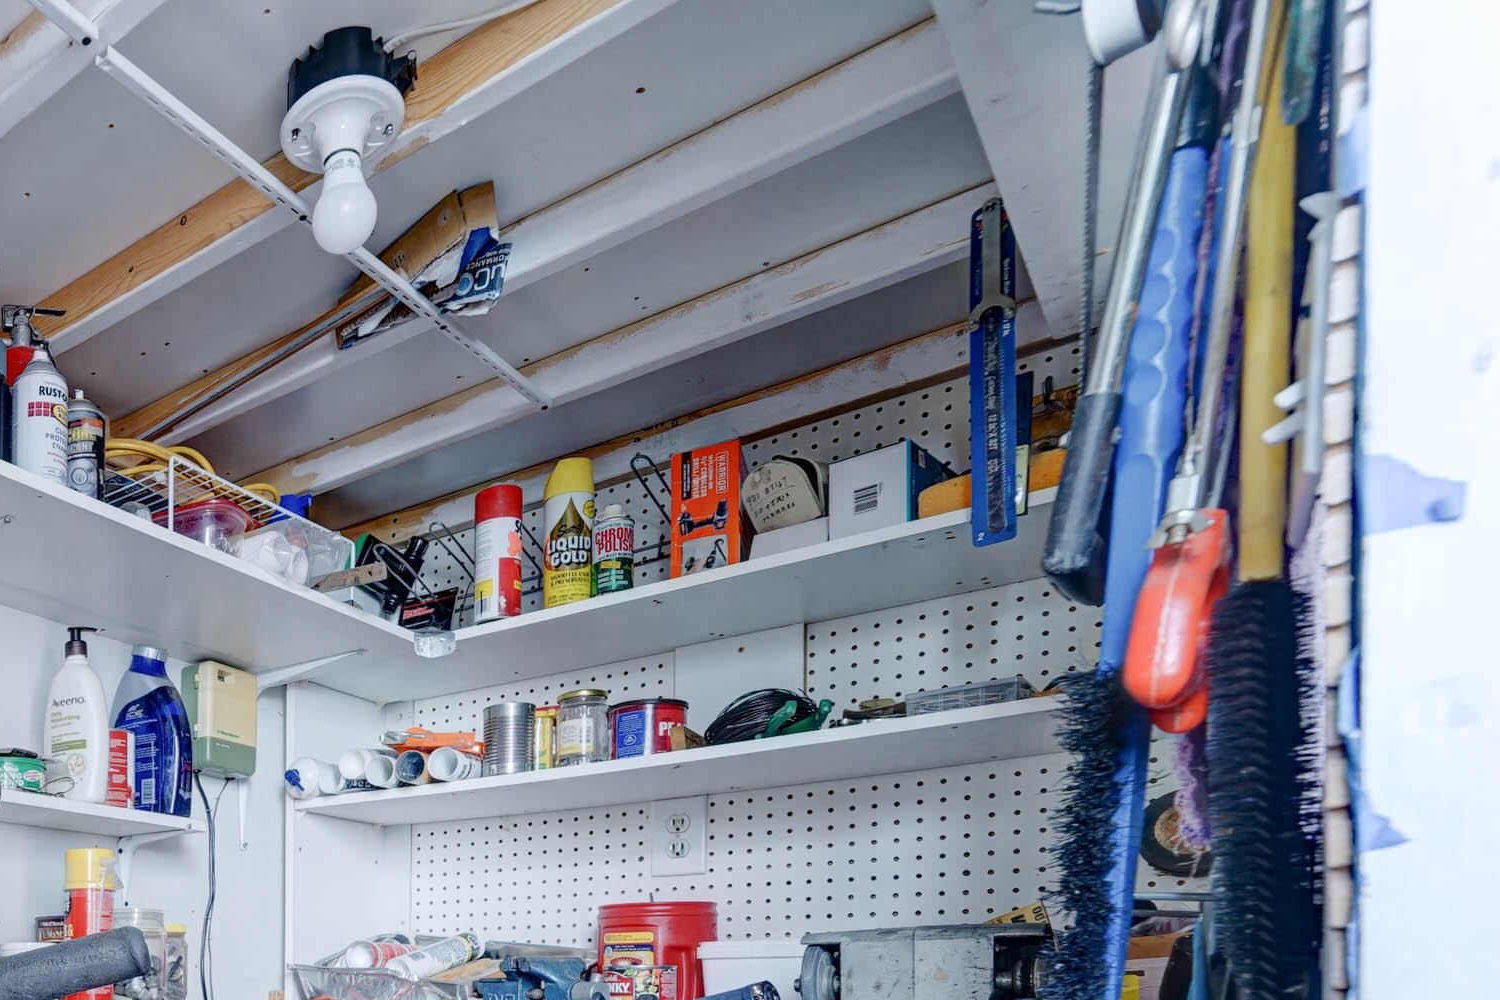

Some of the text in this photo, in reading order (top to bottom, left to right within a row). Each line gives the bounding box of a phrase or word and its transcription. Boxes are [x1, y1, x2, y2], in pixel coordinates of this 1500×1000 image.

[39, 386, 68, 401] RUST-O
[45, 433, 68, 444] PROTE
[55, 427, 68, 438] GLO
[717, 452, 727, 491] WARRIOR
[547, 535, 591, 556] LIQUID
[550, 550, 588, 567] GOLD
[609, 982, 631, 994] NKY
